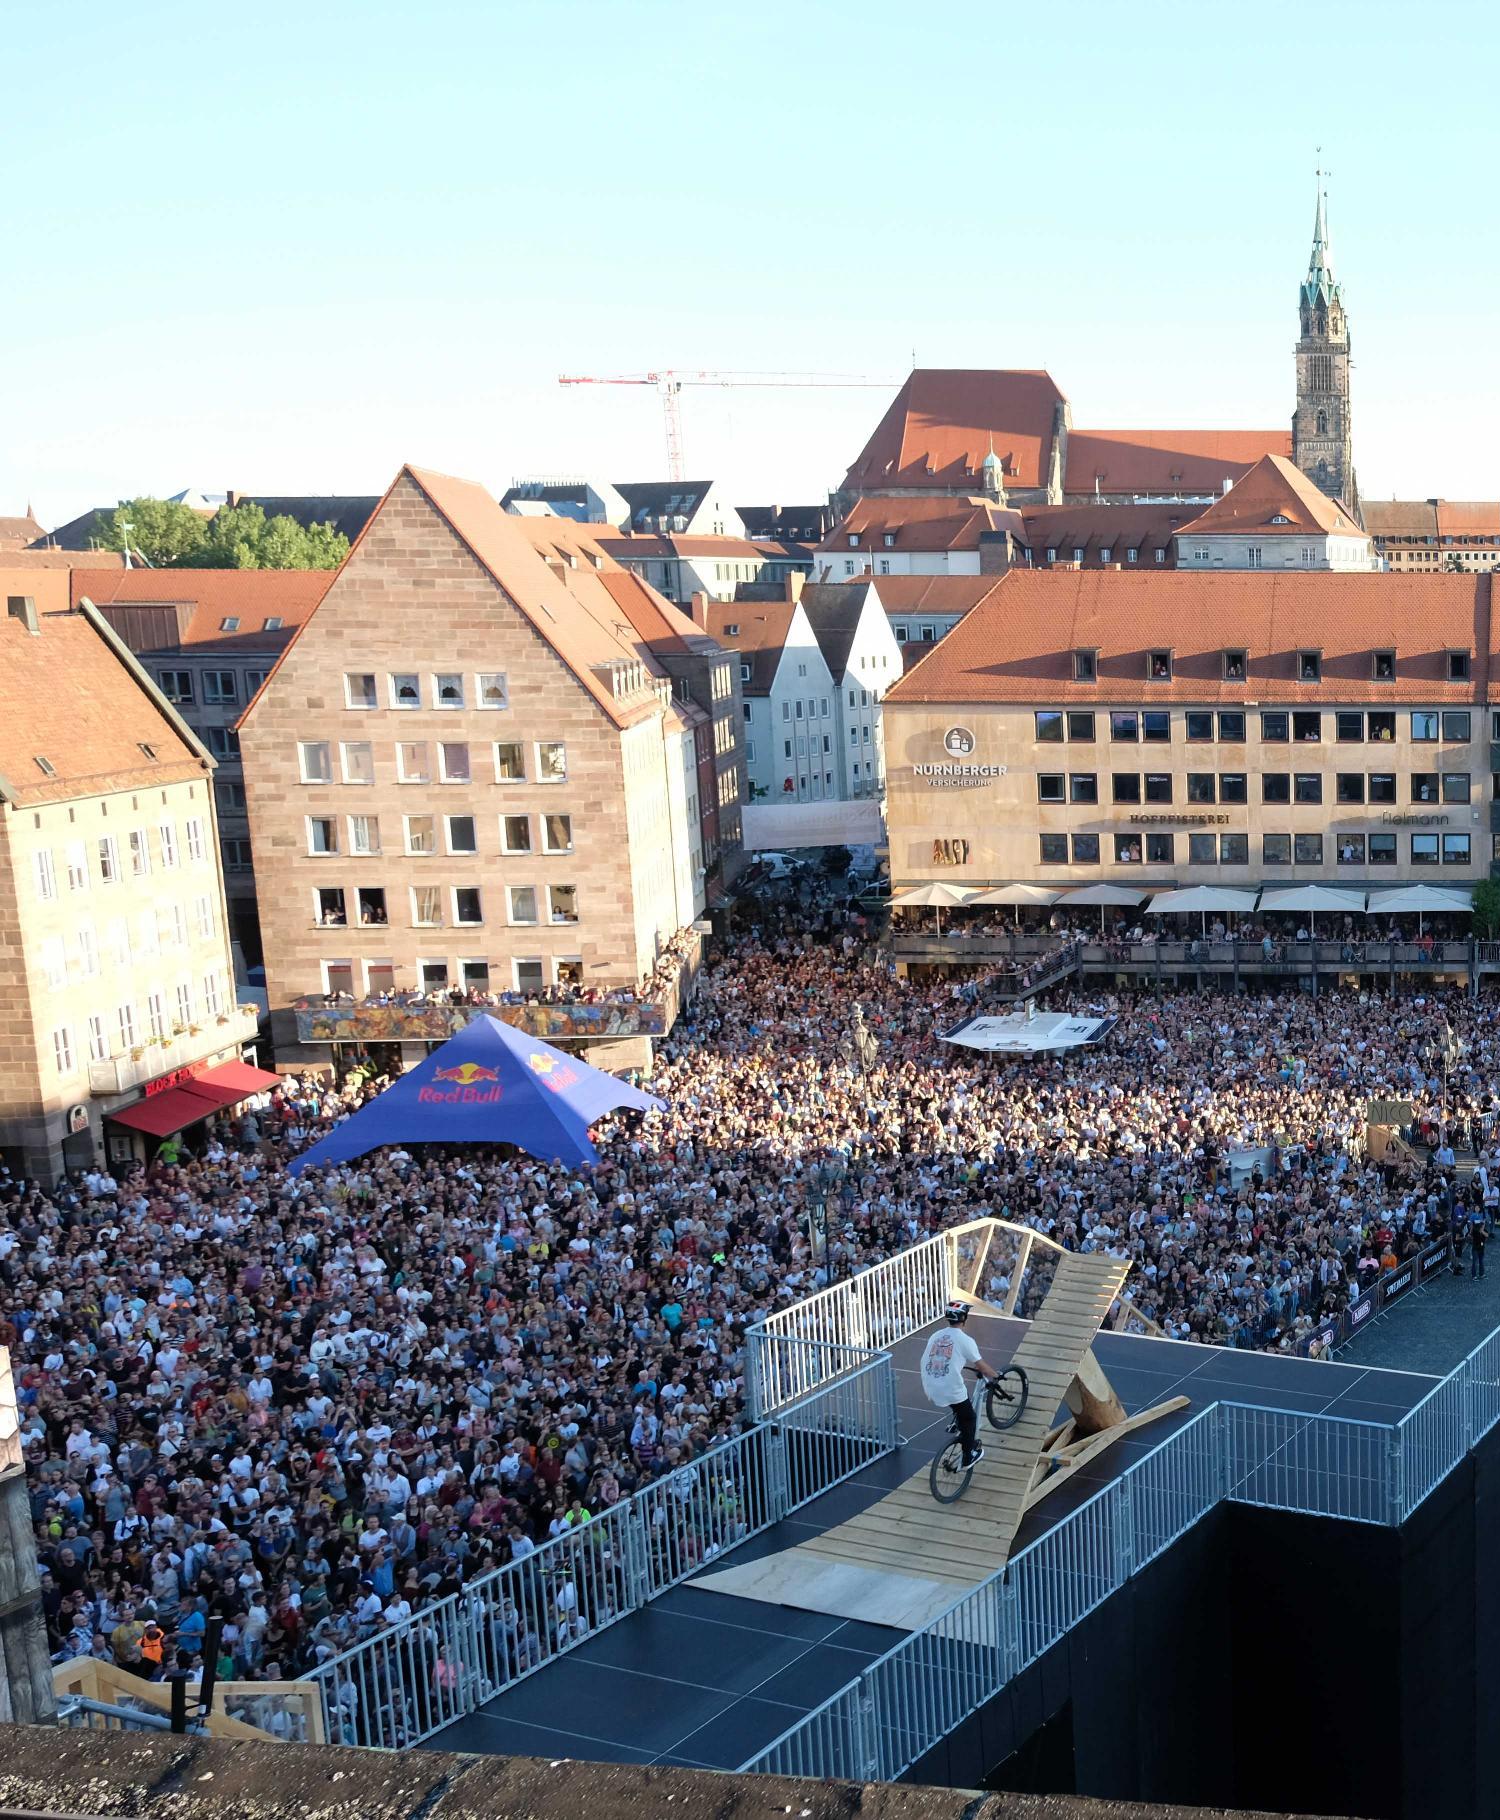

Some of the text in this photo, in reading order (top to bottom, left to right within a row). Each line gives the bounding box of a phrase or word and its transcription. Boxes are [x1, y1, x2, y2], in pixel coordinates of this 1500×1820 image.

[927, 779, 992, 787] VERSICHERUNG
[1130, 814, 1230, 825] HOFPFISTEREI
[1372, 1104, 1411, 1121] NICO
